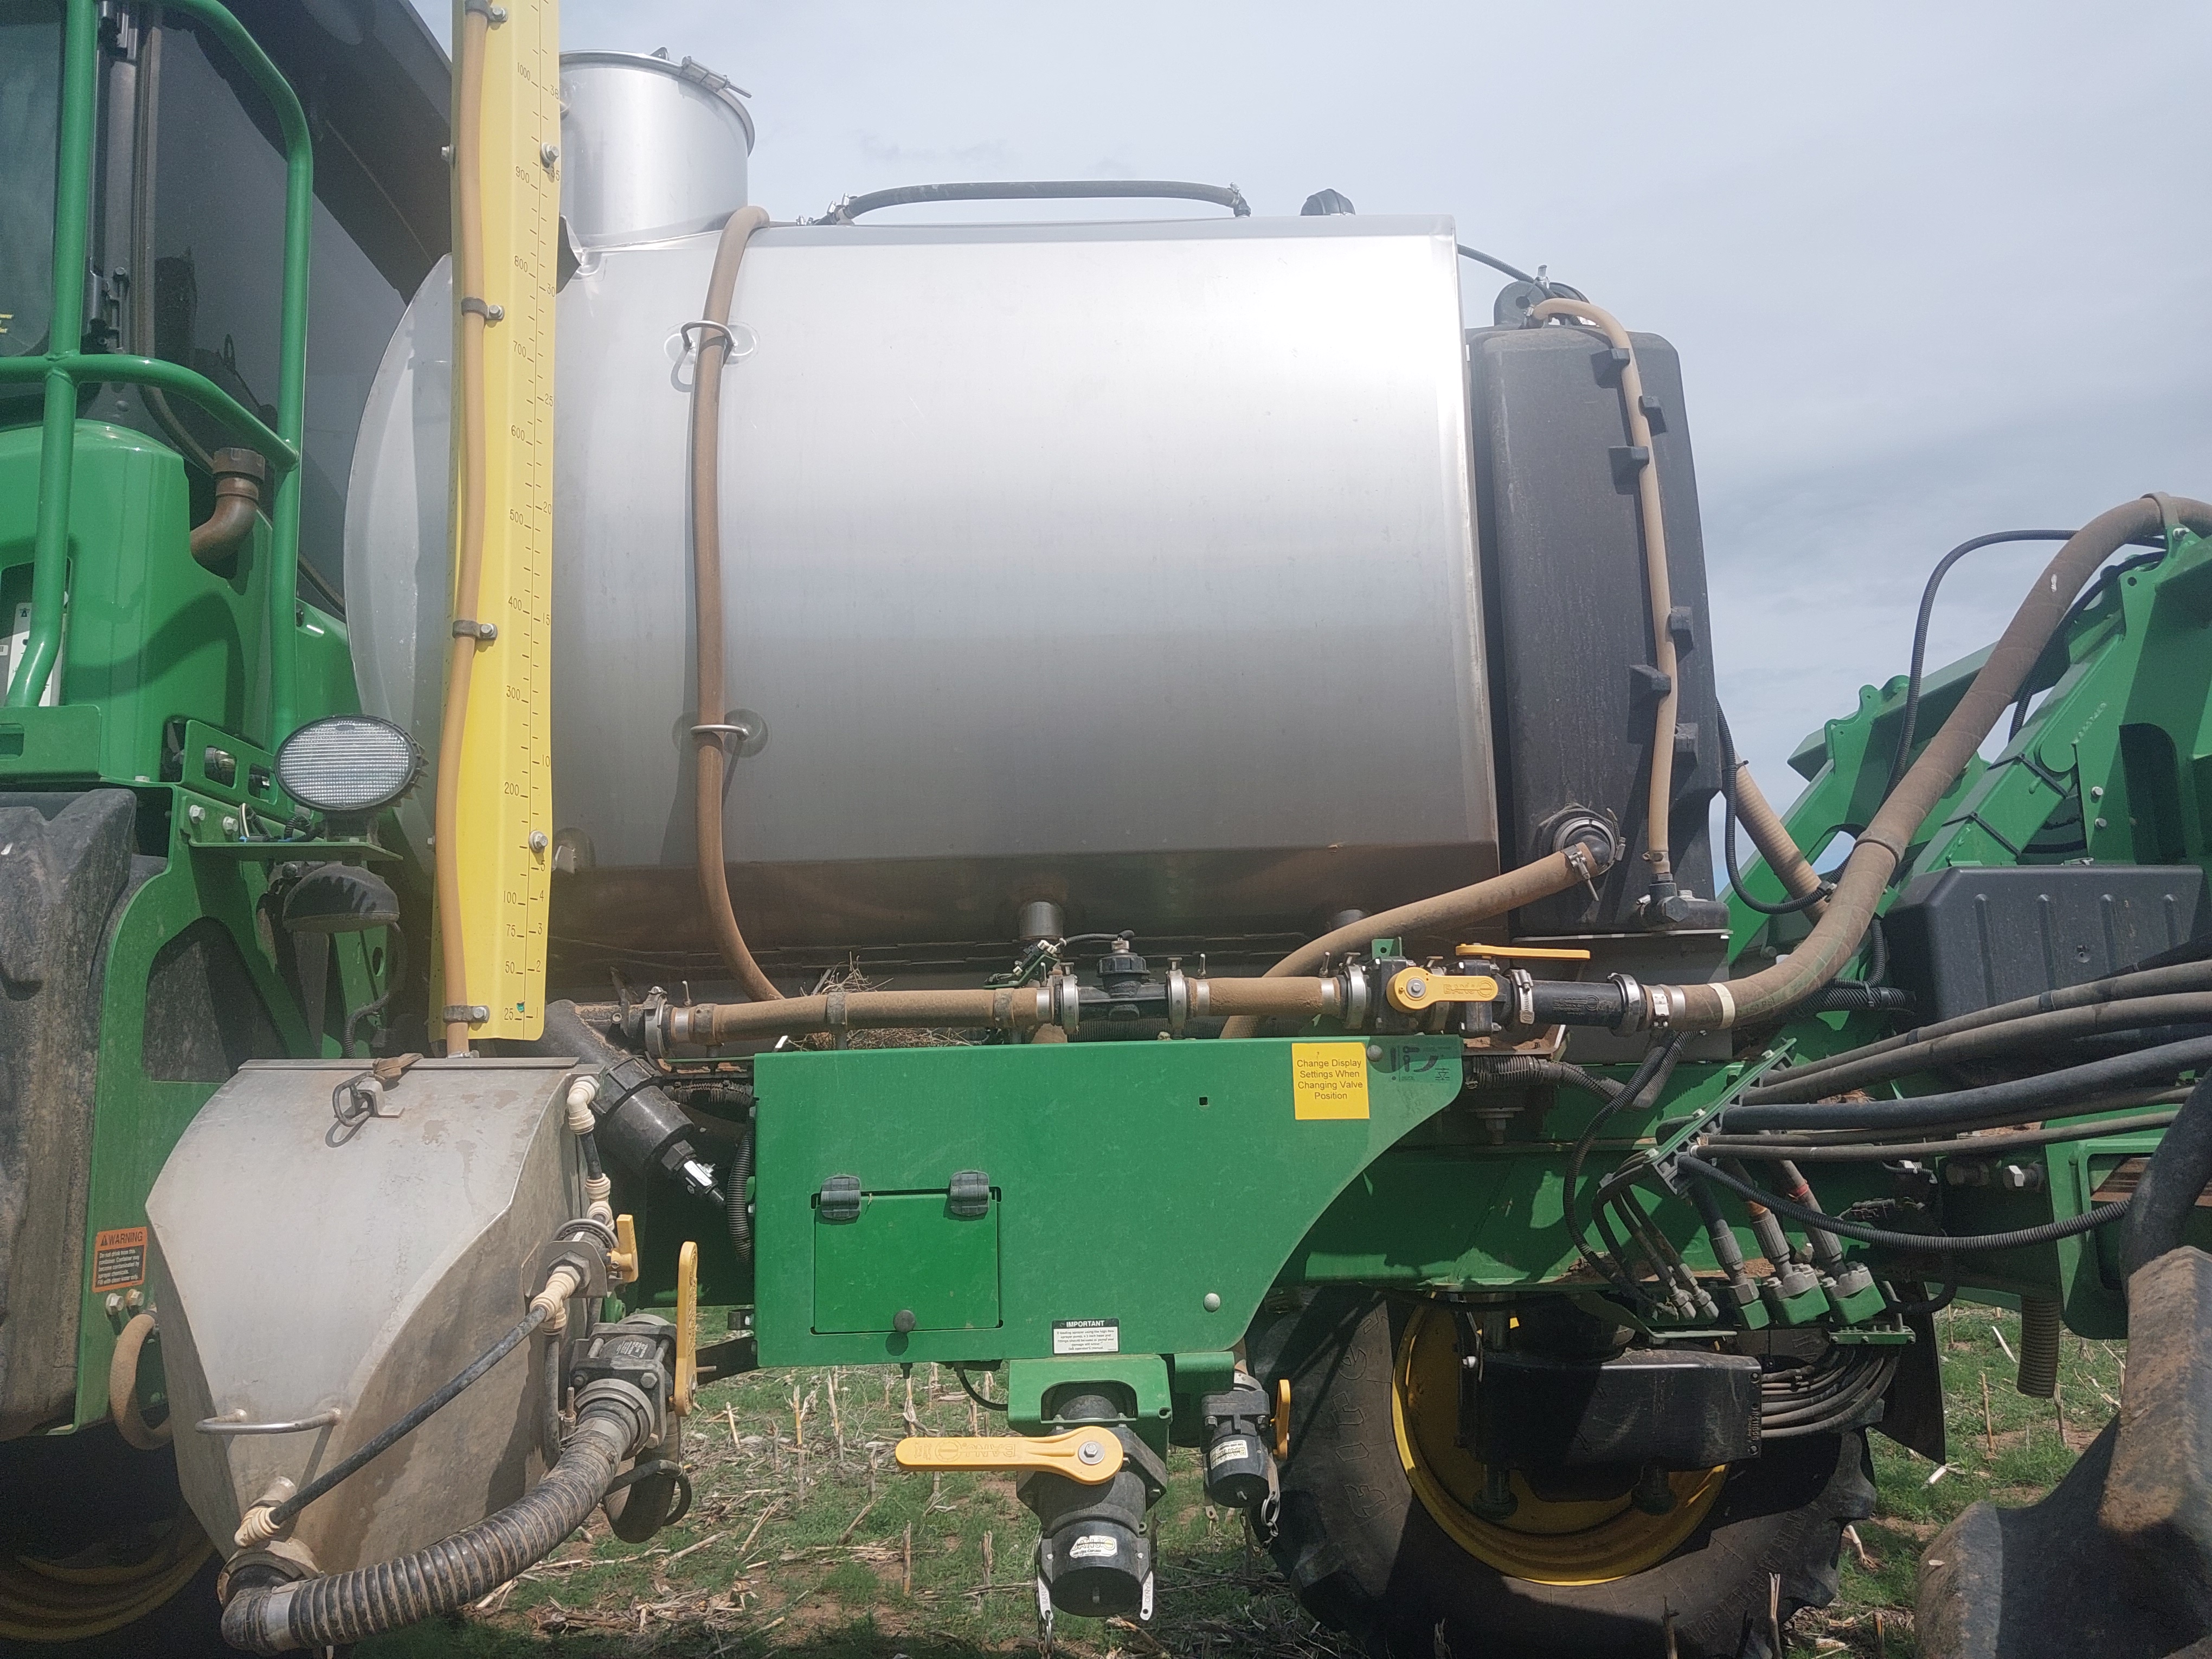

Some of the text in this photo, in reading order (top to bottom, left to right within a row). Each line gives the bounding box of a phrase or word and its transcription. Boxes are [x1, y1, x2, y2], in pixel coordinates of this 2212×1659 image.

[517, 62, 531, 81] 1000
[550, 84, 560, 100] 38
[515, 165, 530, 183] 900
[550, 165, 560, 182] 35
[514, 255, 529, 273] 800
[546, 282, 556, 298] 30
[512, 339, 527, 358] 700
[544, 393, 554, 407] 25
[510, 425, 525, 441] 600
[543, 501, 552, 515] 20
[509, 509, 524, 525] 500
[507, 596, 523, 611] 400
[542, 612, 551, 626] 15
[506, 685, 521, 700] 300
[542, 754, 551, 768] 10
[504, 781, 520, 796] 200
[540, 859, 546, 872] 5
[503, 890, 517, 904] 100
[539, 890, 544, 902] 4
[506, 923, 516, 937] 75
[537, 922, 543, 935] 3
[505, 960, 515, 974] 50
[536, 960, 541, 973] 2
[504, 1007, 514, 1021] 25
[535, 1006, 539, 1019] 1
[1296, 1059, 1362, 1070] Change Display
[1300, 1070, 1360, 1080] Settings When
[1297, 1081, 1363, 1090] Changing Valve
[1314, 1091, 1348, 1100] Position
[108, 1231, 143, 1245] WARNING
